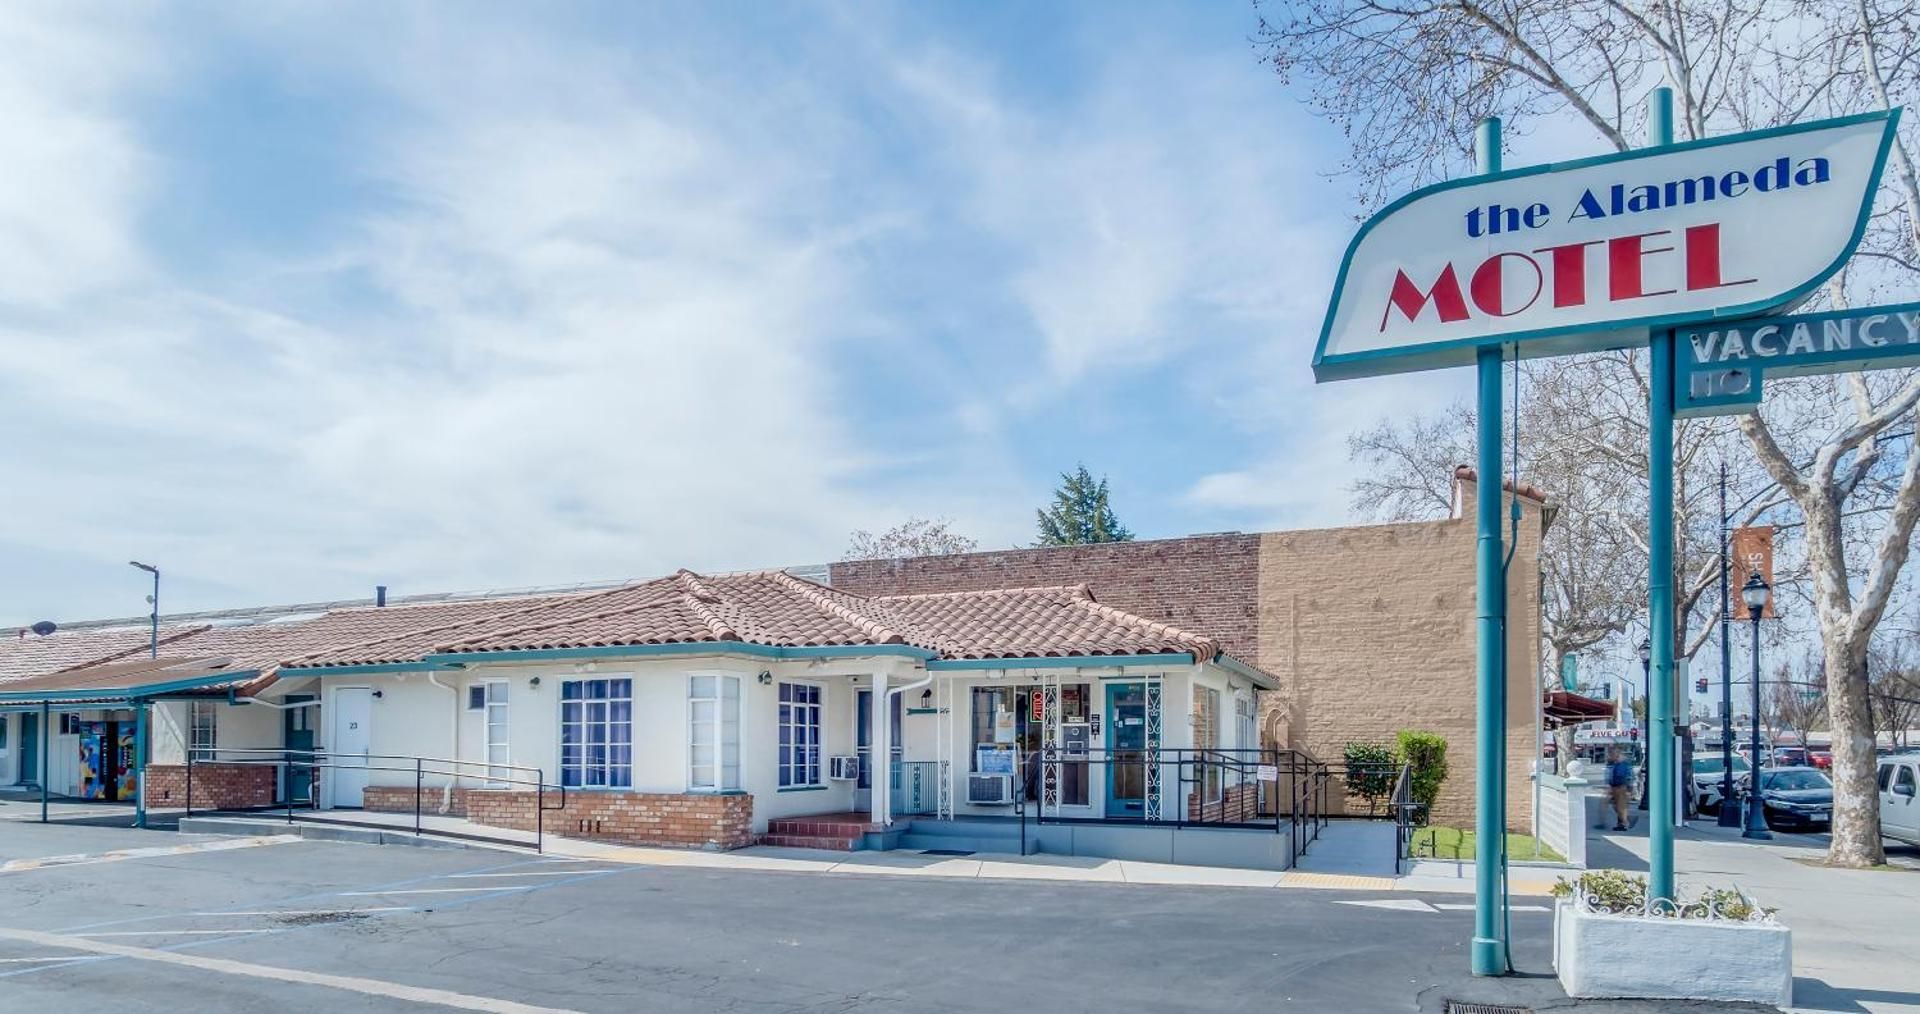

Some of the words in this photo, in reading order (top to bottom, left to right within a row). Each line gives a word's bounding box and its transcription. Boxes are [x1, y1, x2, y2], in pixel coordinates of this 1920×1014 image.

[1464, 203, 1550, 238] the
[1568, 157, 1831, 223] Alameda
[1380, 223, 1758, 333] MOTEL
[1689, 312, 1920, 363] VACANCY
